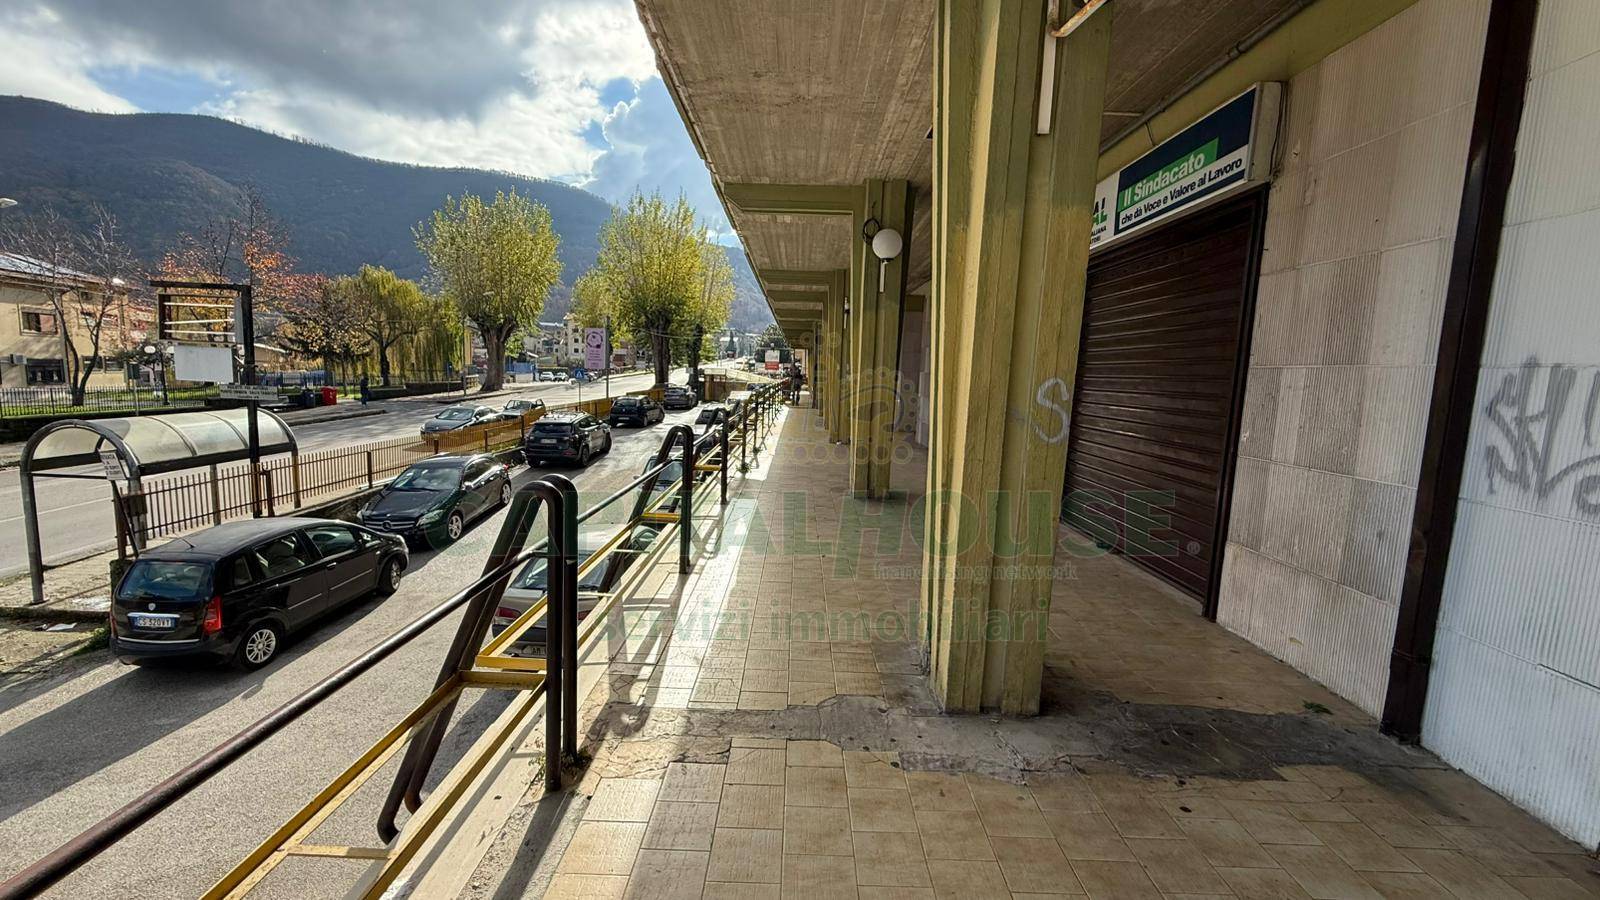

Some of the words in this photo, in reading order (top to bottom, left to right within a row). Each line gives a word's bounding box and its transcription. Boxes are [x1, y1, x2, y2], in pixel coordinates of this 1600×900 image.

[1121, 212, 1133, 225] che
[1143, 198, 1162, 213] Voce
[1162, 195, 1168, 205] e
[1169, 181, 1196, 201] Valore
[1197, 172, 1206, 187] al
[1207, 158, 1243, 183] Lavoro
[1123, 185, 1132, 207] Il
[1133, 153, 1206, 201] Sindacato
